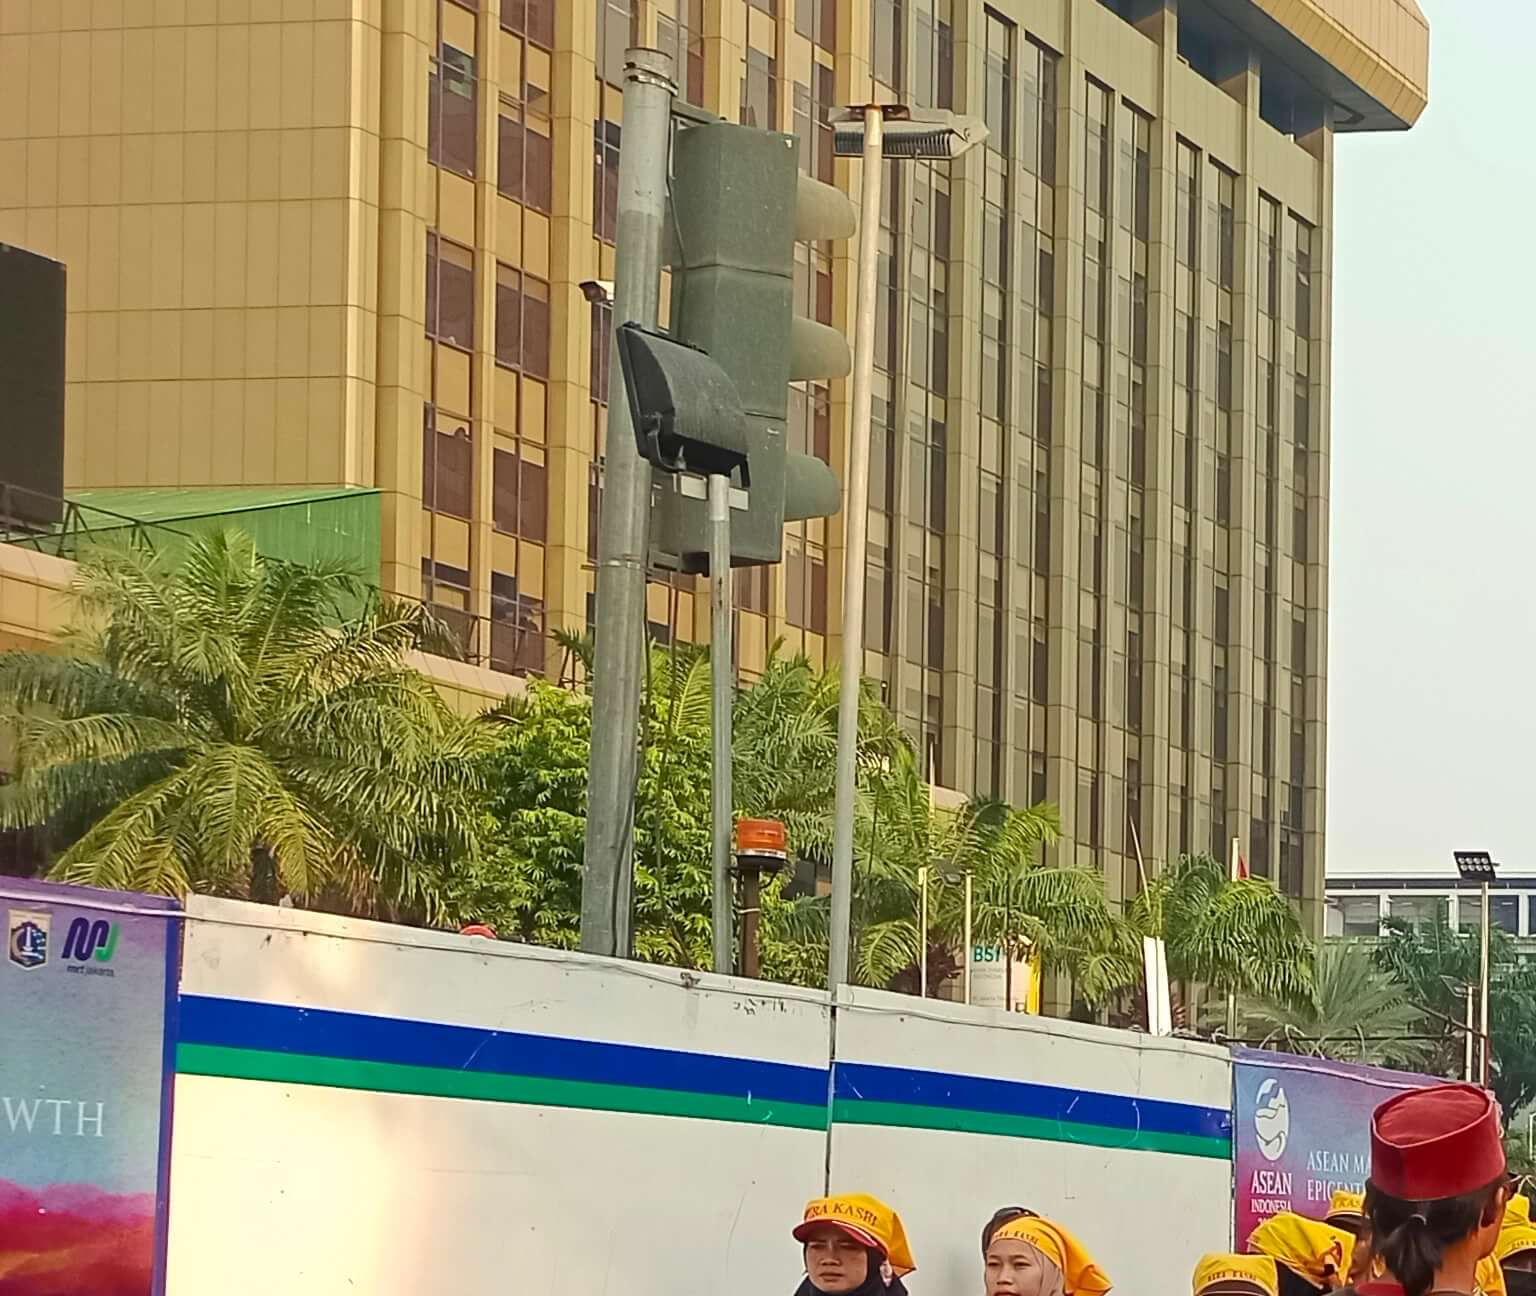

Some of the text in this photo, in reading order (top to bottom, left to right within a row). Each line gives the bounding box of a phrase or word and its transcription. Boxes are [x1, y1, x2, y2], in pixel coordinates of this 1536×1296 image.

[3, 1097, 105, 1137] WTH
[1306, 1151, 1350, 1171] ASEAN
[1250, 1170, 1293, 1195] ASEAN
[832, 1202, 878, 1228] KASBI
[1250, 1198, 1293, 1213] INDONESIA
